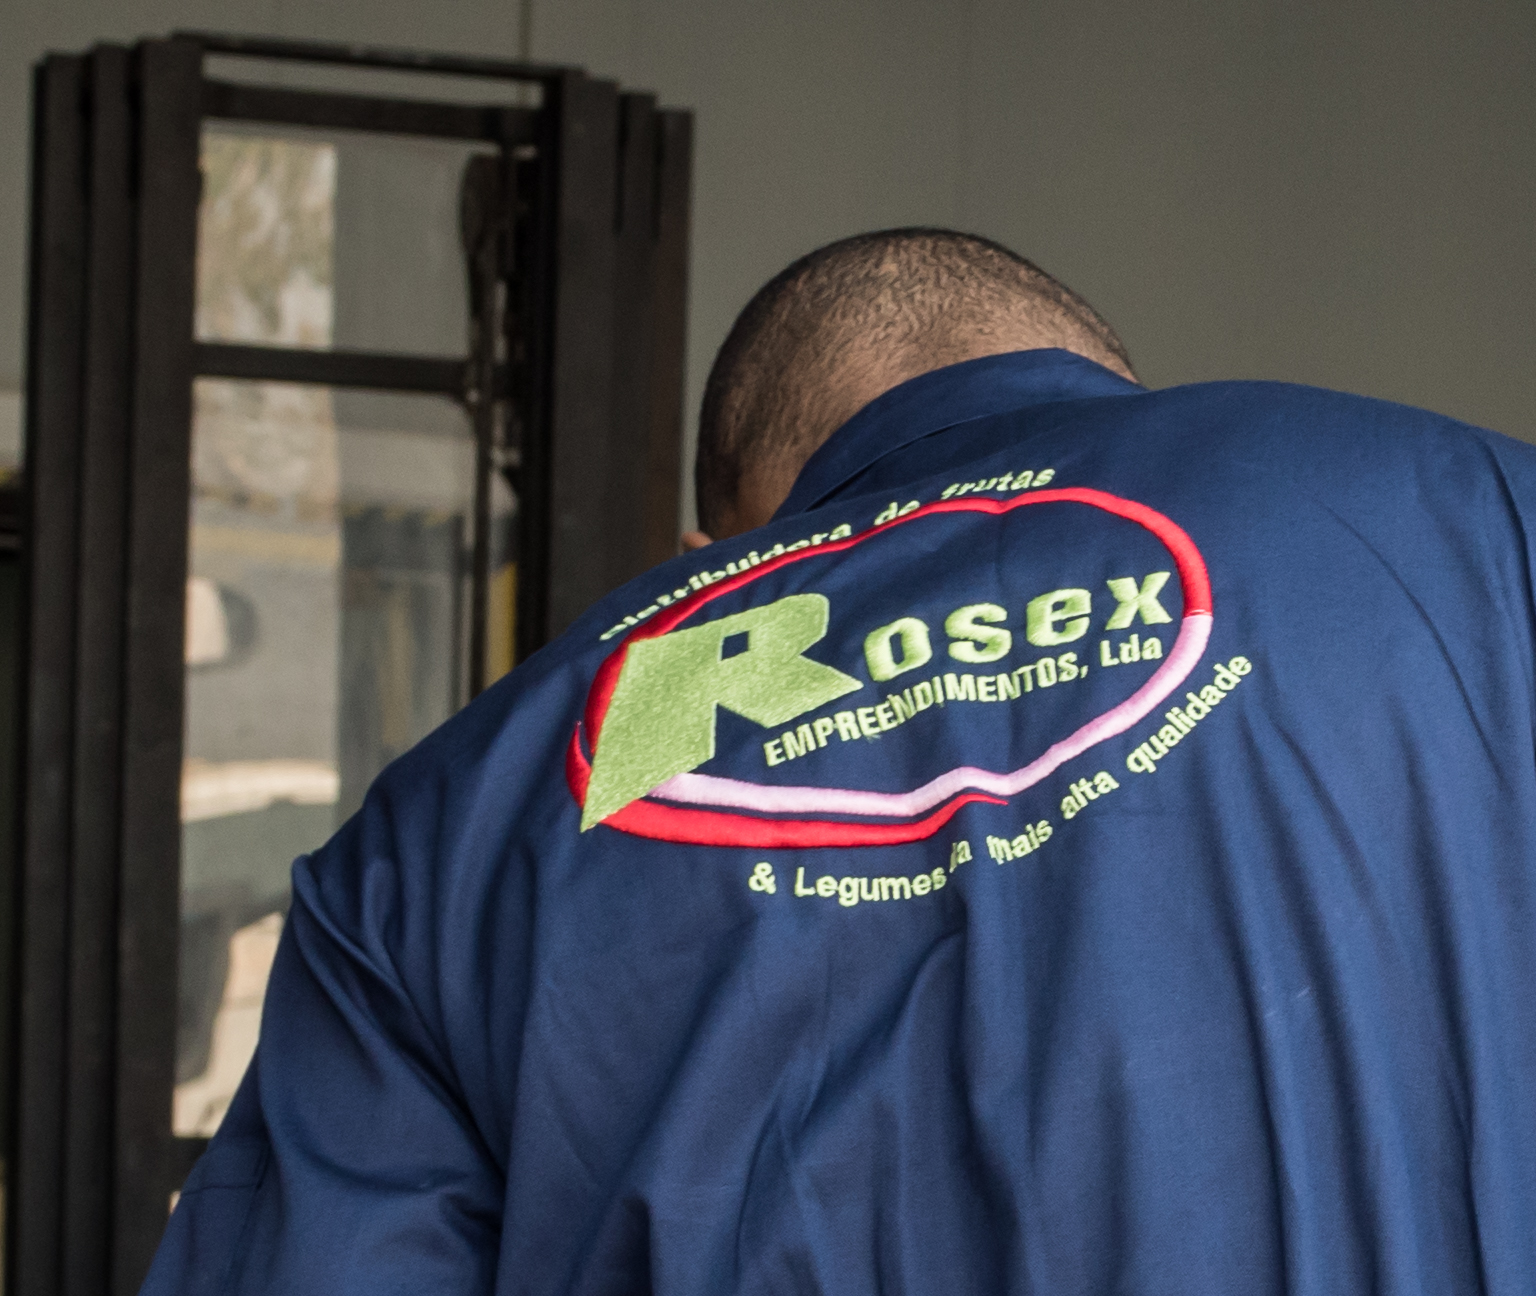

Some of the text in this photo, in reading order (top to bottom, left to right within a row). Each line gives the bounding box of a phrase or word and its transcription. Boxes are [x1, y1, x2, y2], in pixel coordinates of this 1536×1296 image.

[873, 500, 921, 526] de
[940, 468, 1056, 500] frutas
[763, 634, 1163, 767] EMPREENDIMENTOS, Lda
[748, 862, 777, 894] &
[794, 866, 948, 907] Legumes
[986, 819, 1053, 866] mais
[1060, 770, 1120, 820] alta
[1126, 655, 1253, 774] qualidade
